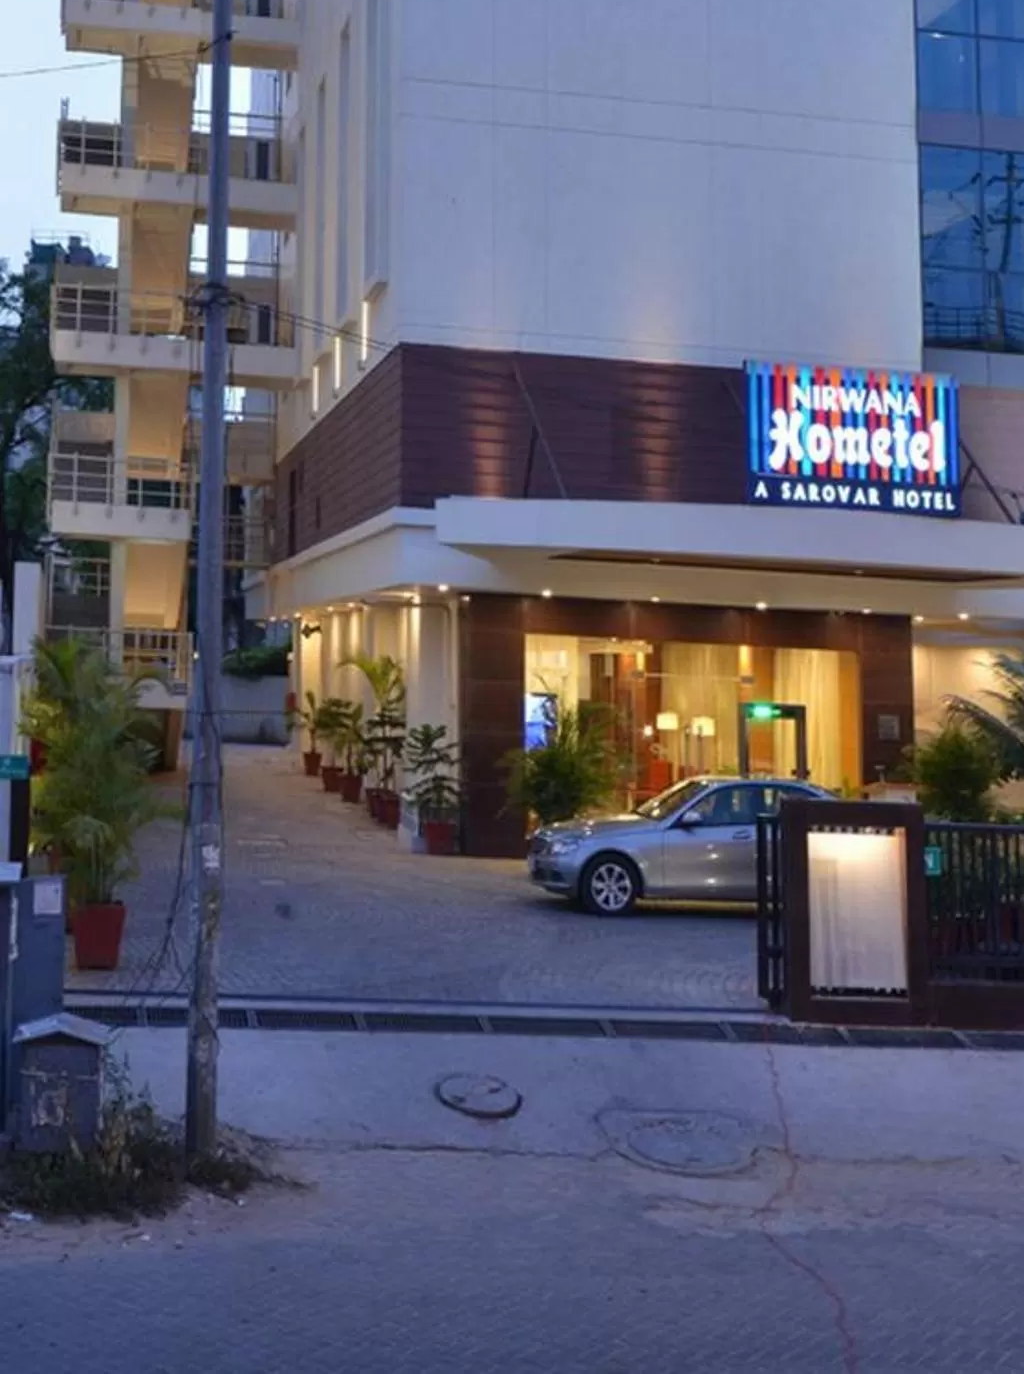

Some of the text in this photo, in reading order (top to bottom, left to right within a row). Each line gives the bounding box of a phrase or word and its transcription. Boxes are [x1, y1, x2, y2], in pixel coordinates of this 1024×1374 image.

[791, 383, 922, 417] NIRWANA
[769, 408, 946, 472] Hometel
[754, 481, 955, 510] A SAROVAR HOTEL
